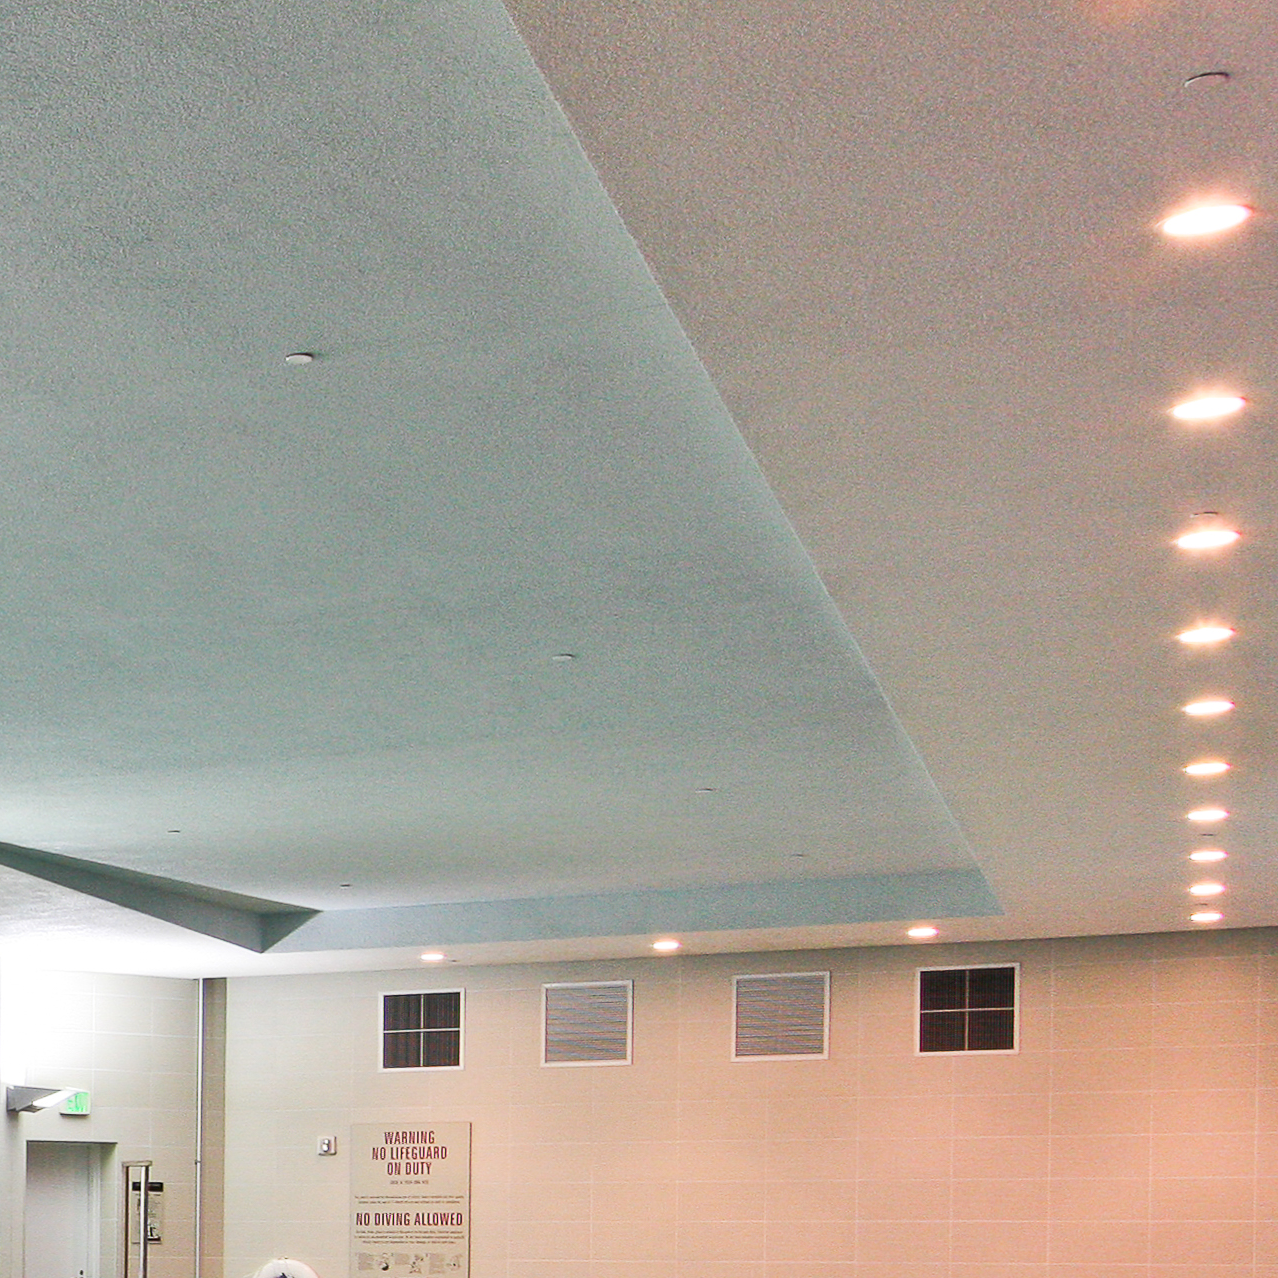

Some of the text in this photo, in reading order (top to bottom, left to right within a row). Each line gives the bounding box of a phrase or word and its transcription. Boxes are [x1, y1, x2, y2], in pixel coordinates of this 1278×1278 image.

[384, 1130, 436, 1145] WARNING
[372, 1146, 448, 1160] NO LIFEGUARD
[387, 1161, 432, 1175] ON DUTY
[356, 1212, 463, 1226] NO DIVING ALLOWED
